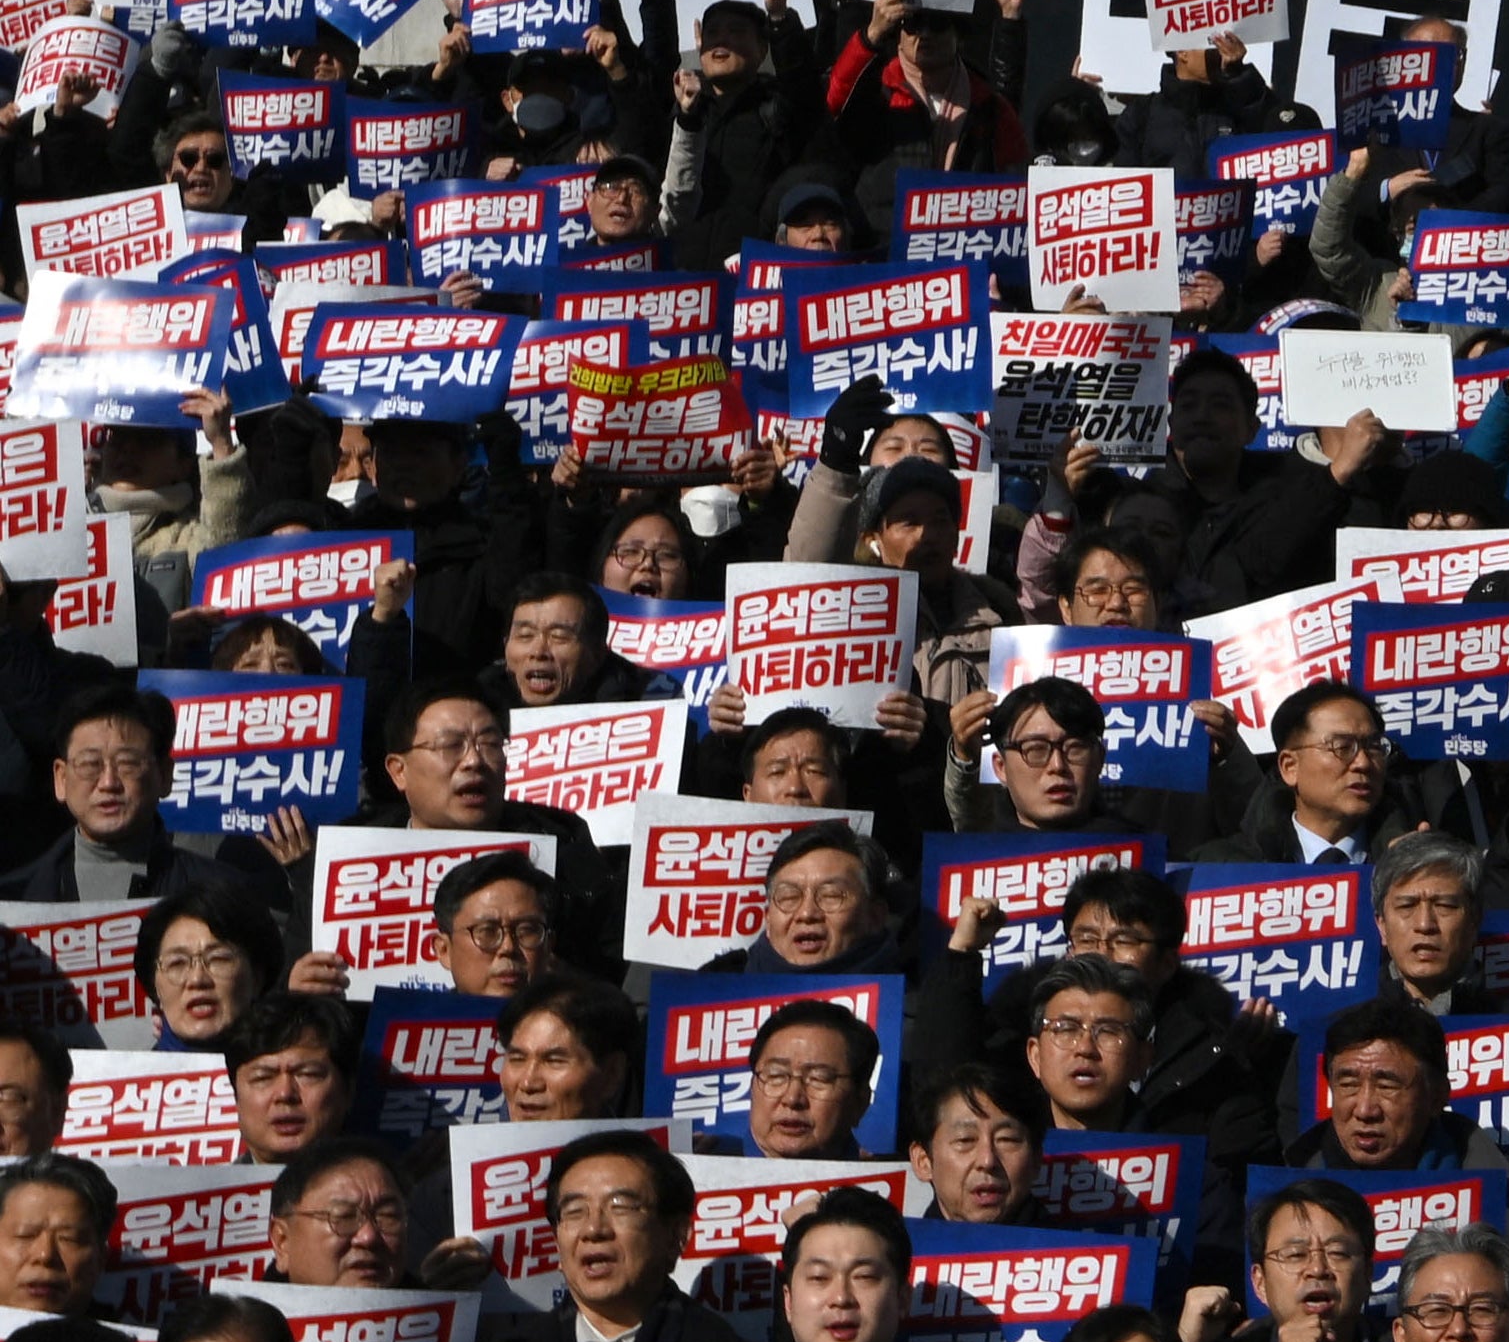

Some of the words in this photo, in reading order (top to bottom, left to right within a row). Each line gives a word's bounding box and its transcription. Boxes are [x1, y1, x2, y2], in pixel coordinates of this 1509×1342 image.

[39, 197, 158, 256] 윤석열은
[418, 194, 538, 241] 내란행위
[1038, 181, 1144, 239] 윤석열은
[420, 236, 546, 278] 즉각수사!
[1040, 231, 1161, 286] 사퇴하라!
[806, 273, 963, 343] 내란행위
[325, 317, 498, 352] 내란행위
[999, 320, 1160, 359] 친일매국노
[317, 349, 502, 396] 즉각수사!
[811, 326, 978, 394] 즉각수사!
[999, 360, 1142, 400] 윤석열을
[572, 390, 722, 435] 윤석열을
[1015, 403, 1164, 442] 탄핵하자!
[912, 1254, 1118, 1315] 내란행위
